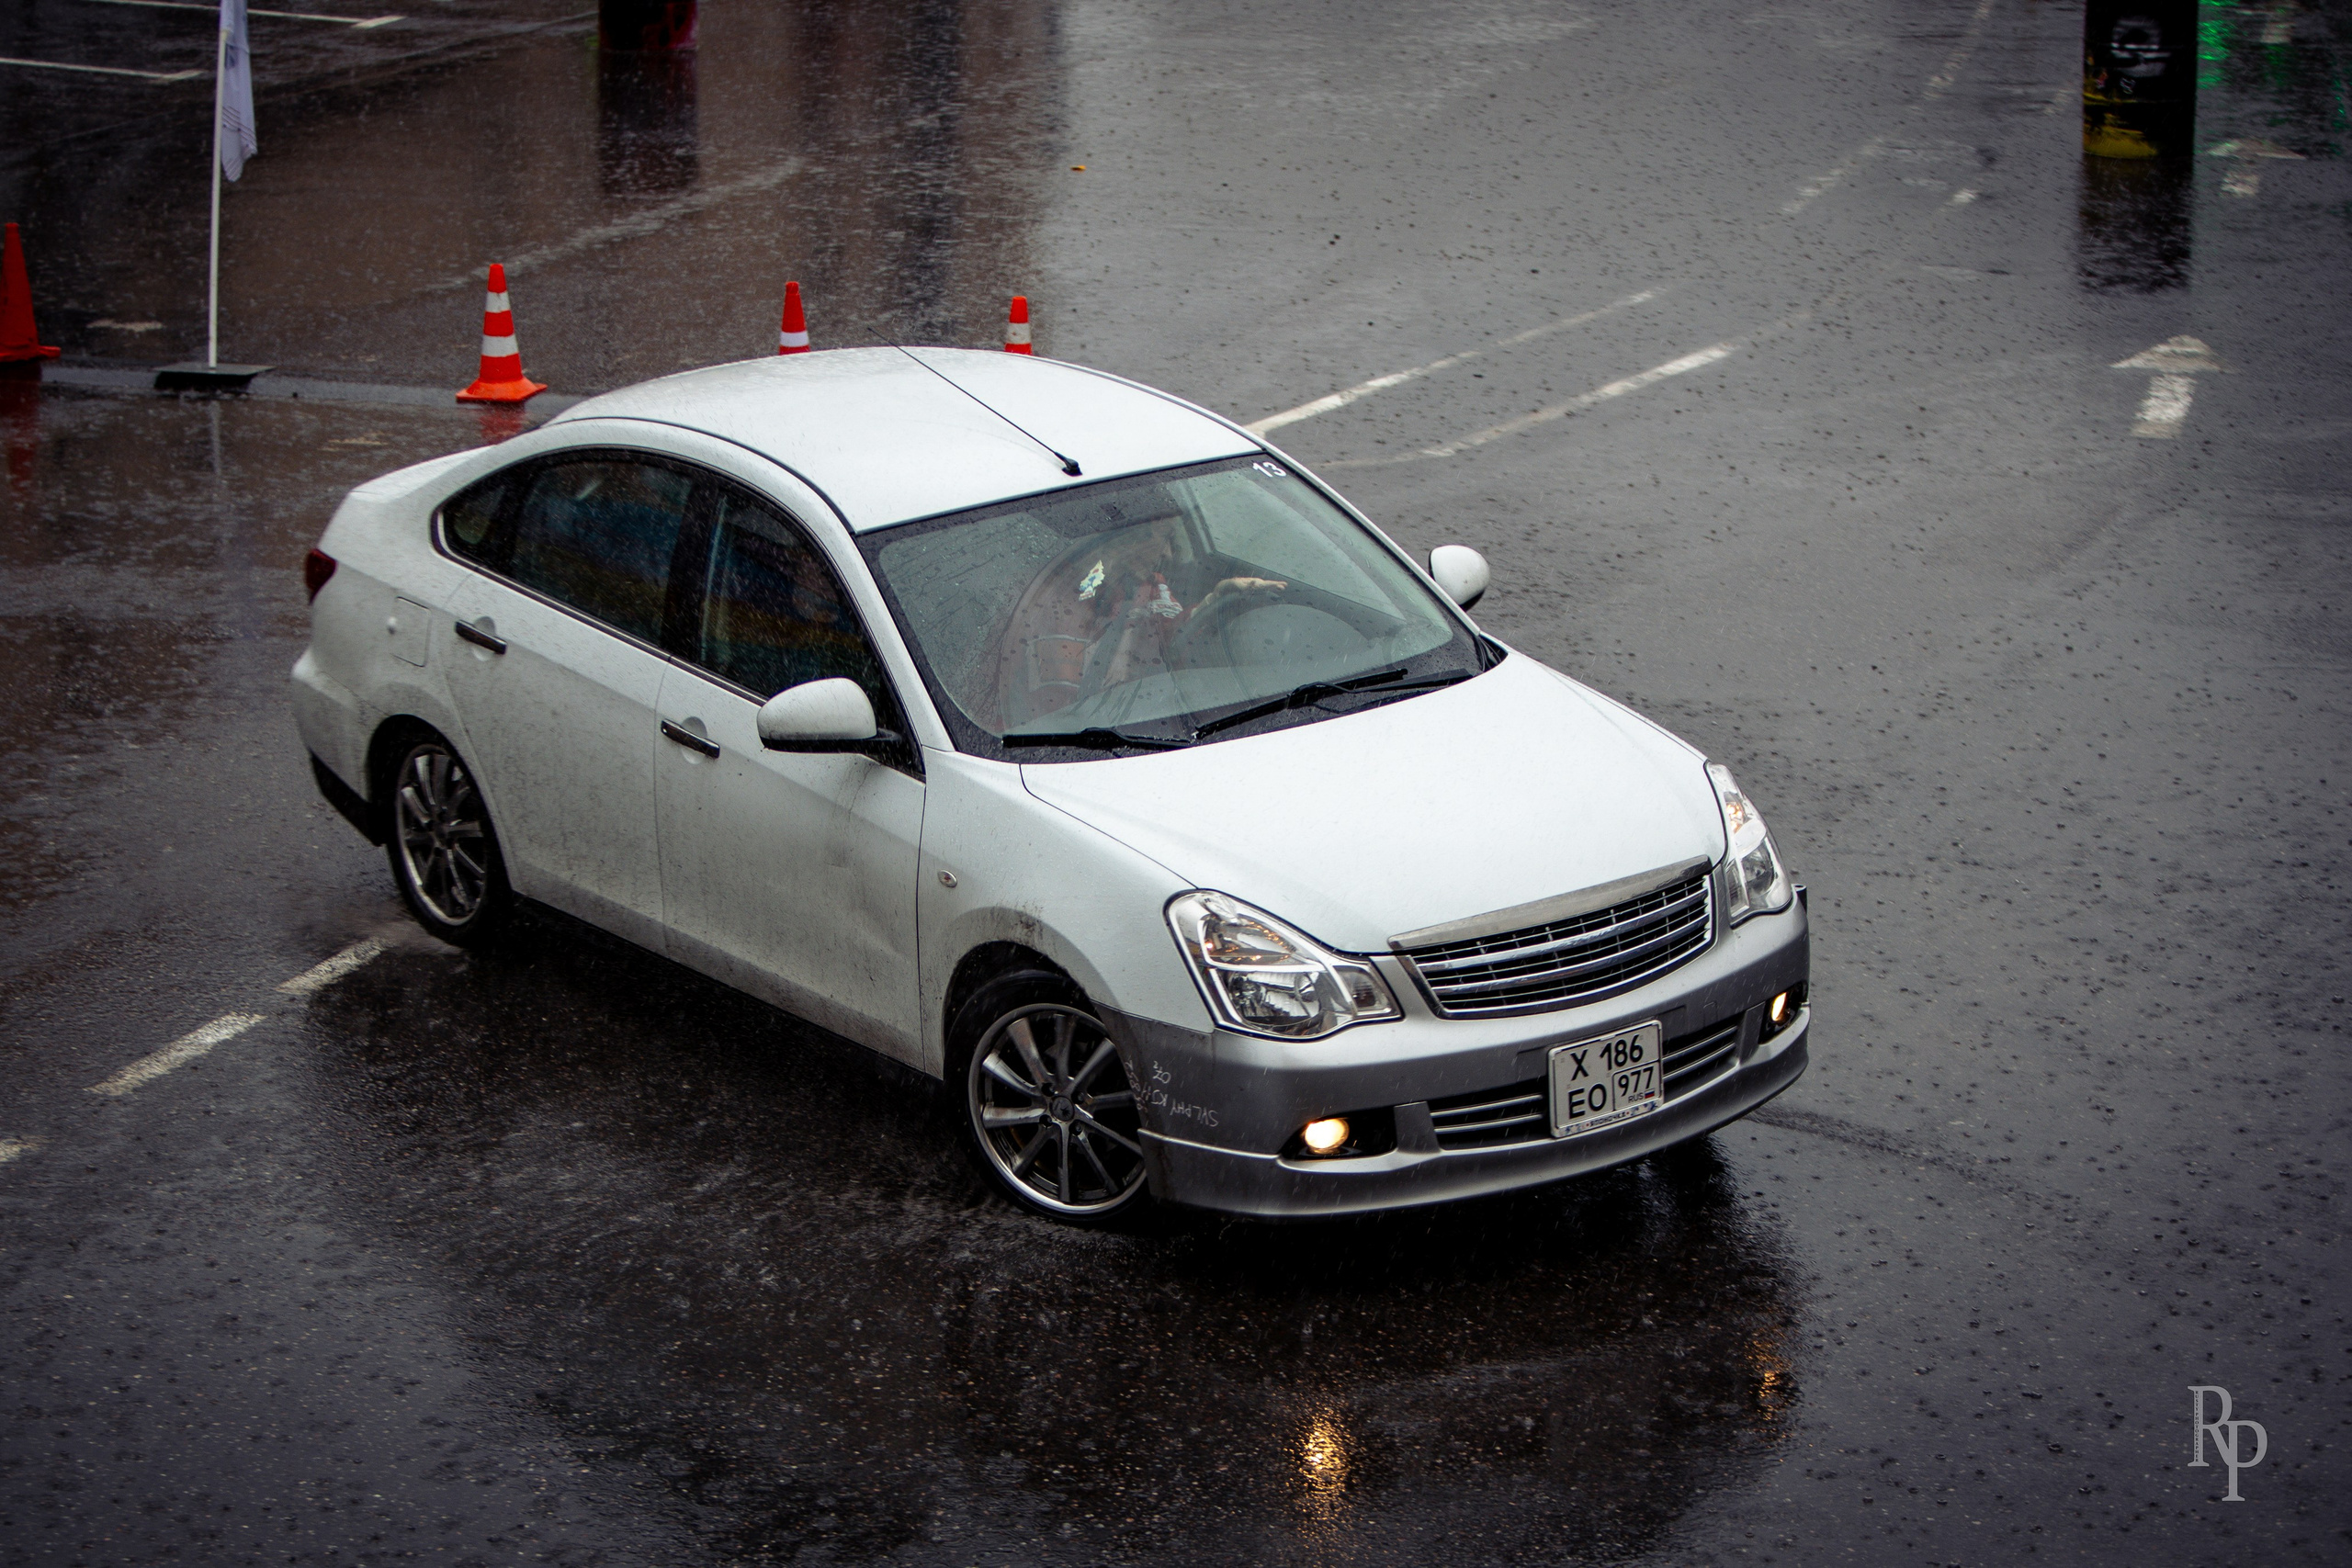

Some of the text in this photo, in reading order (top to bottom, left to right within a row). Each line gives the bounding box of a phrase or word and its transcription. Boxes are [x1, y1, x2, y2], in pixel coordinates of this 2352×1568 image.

[1252, 461, 1287, 478] 13
[1569, 1033, 1644, 1081] X 186
[1567, 1066, 1654, 1120] EO 977
[1628, 1091, 1645, 1103] RUS
[1170, 1099, 1219, 1127] SYLPHY
